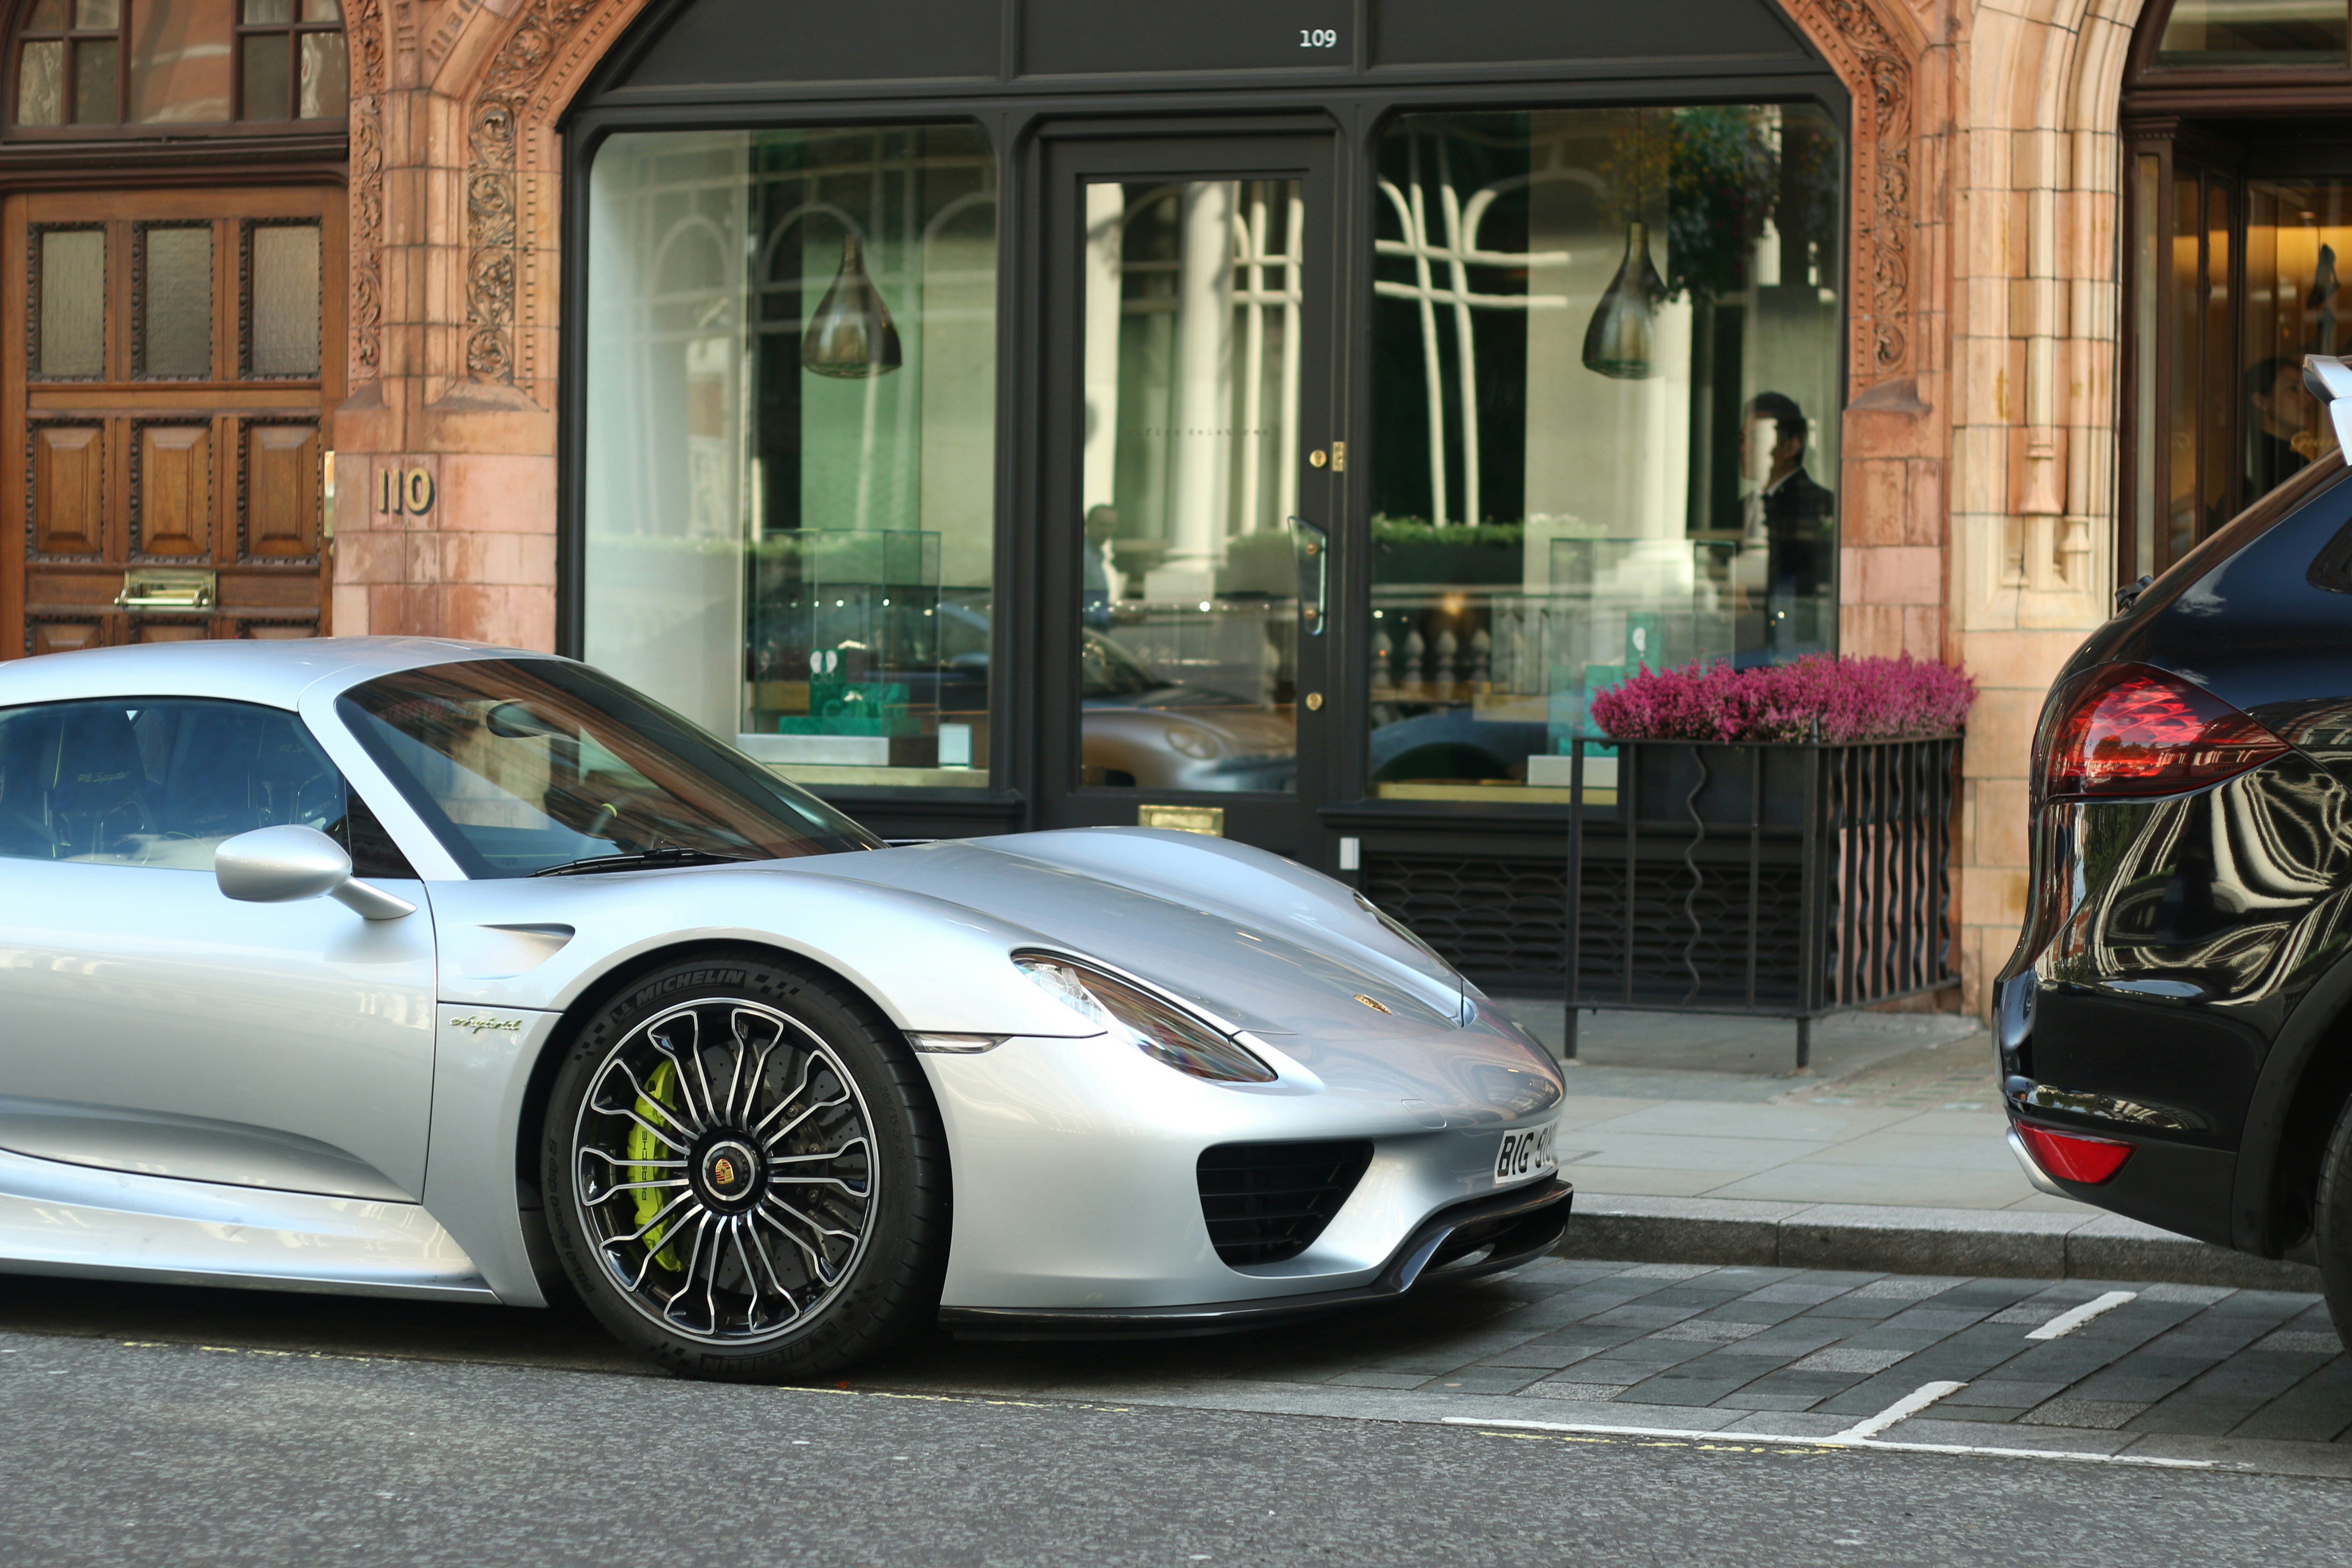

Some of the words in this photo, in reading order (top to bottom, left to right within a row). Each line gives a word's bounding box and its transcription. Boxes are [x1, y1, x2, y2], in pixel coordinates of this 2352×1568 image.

[1299, 29, 1337, 48] 109
[378, 467, 434, 515] 110
[636, 970, 745, 1007] MICHELIN
[1497, 1132, 1534, 1178] BIG
[548, 1157, 558, 1193] Cup
[550, 1196, 573, 1249] Sport
[566, 1251, 596, 1292] Pilot
[703, 1337, 812, 1372] MICHELIN
